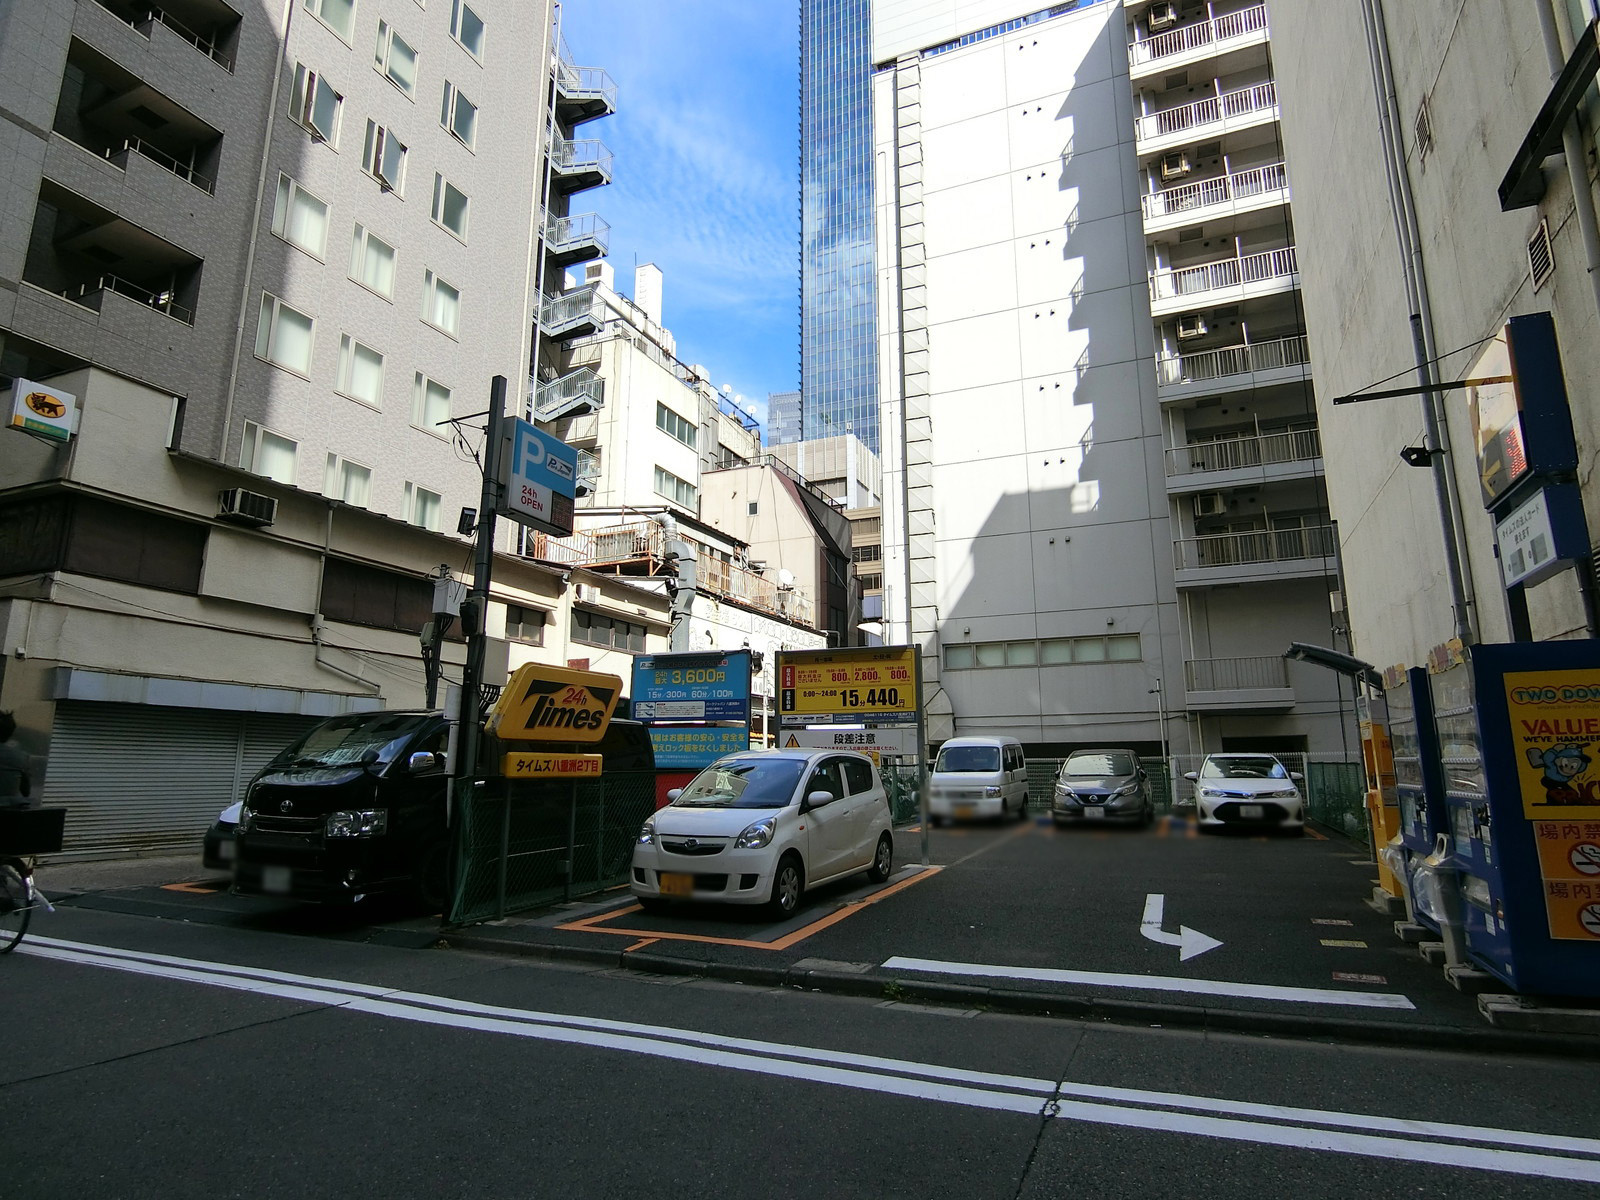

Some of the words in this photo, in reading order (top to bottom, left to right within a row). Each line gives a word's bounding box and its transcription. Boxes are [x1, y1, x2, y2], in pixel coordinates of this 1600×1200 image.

[519, 431, 545, 480] P
[521, 485, 538, 498] 24h
[521, 496, 543, 512] OPEN
[671, 668, 726, 686] 3,600円
[562, 687, 587, 705] 24h
[1515, 689, 1557, 701] TWO
[524, 695, 605, 730] Times
[833, 733, 876, 745] 段差注意
[1523, 735, 1553, 743] WE'VE
[516, 759, 599, 773] タイムズ八重洲2丁目
